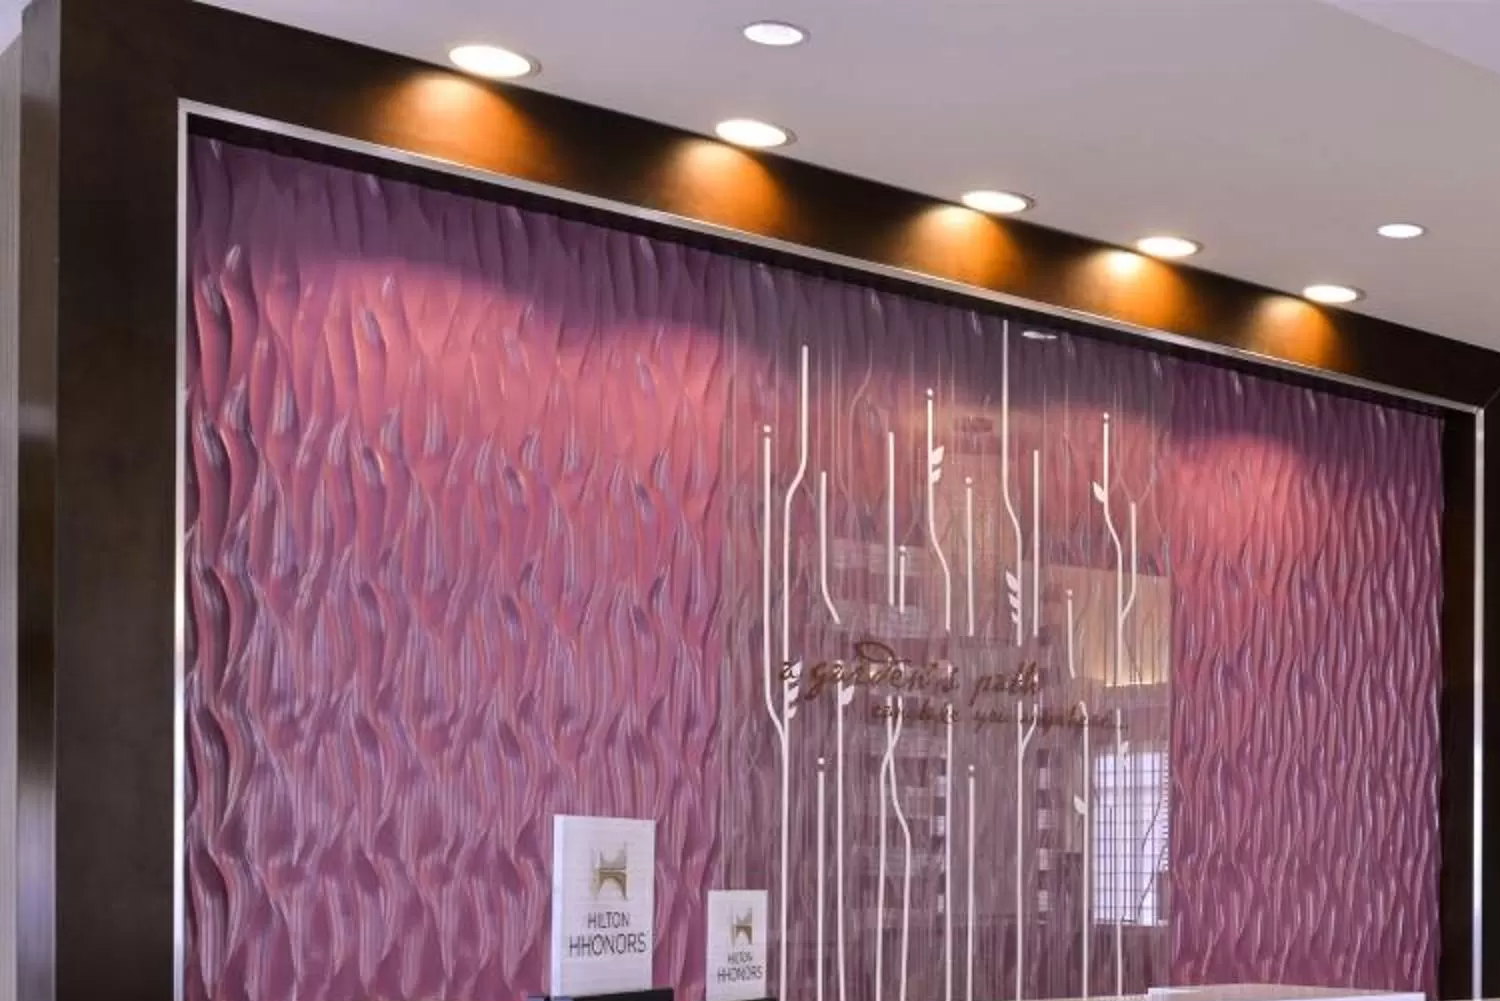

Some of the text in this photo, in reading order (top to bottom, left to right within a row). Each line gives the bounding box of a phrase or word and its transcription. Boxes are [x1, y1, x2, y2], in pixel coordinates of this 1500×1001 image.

[586, 910, 630, 929] HILTON
[569, 932, 647, 957] HHONORS
[727, 951, 753, 965] HILTON
[717, 965, 763, 984] HHONORS
